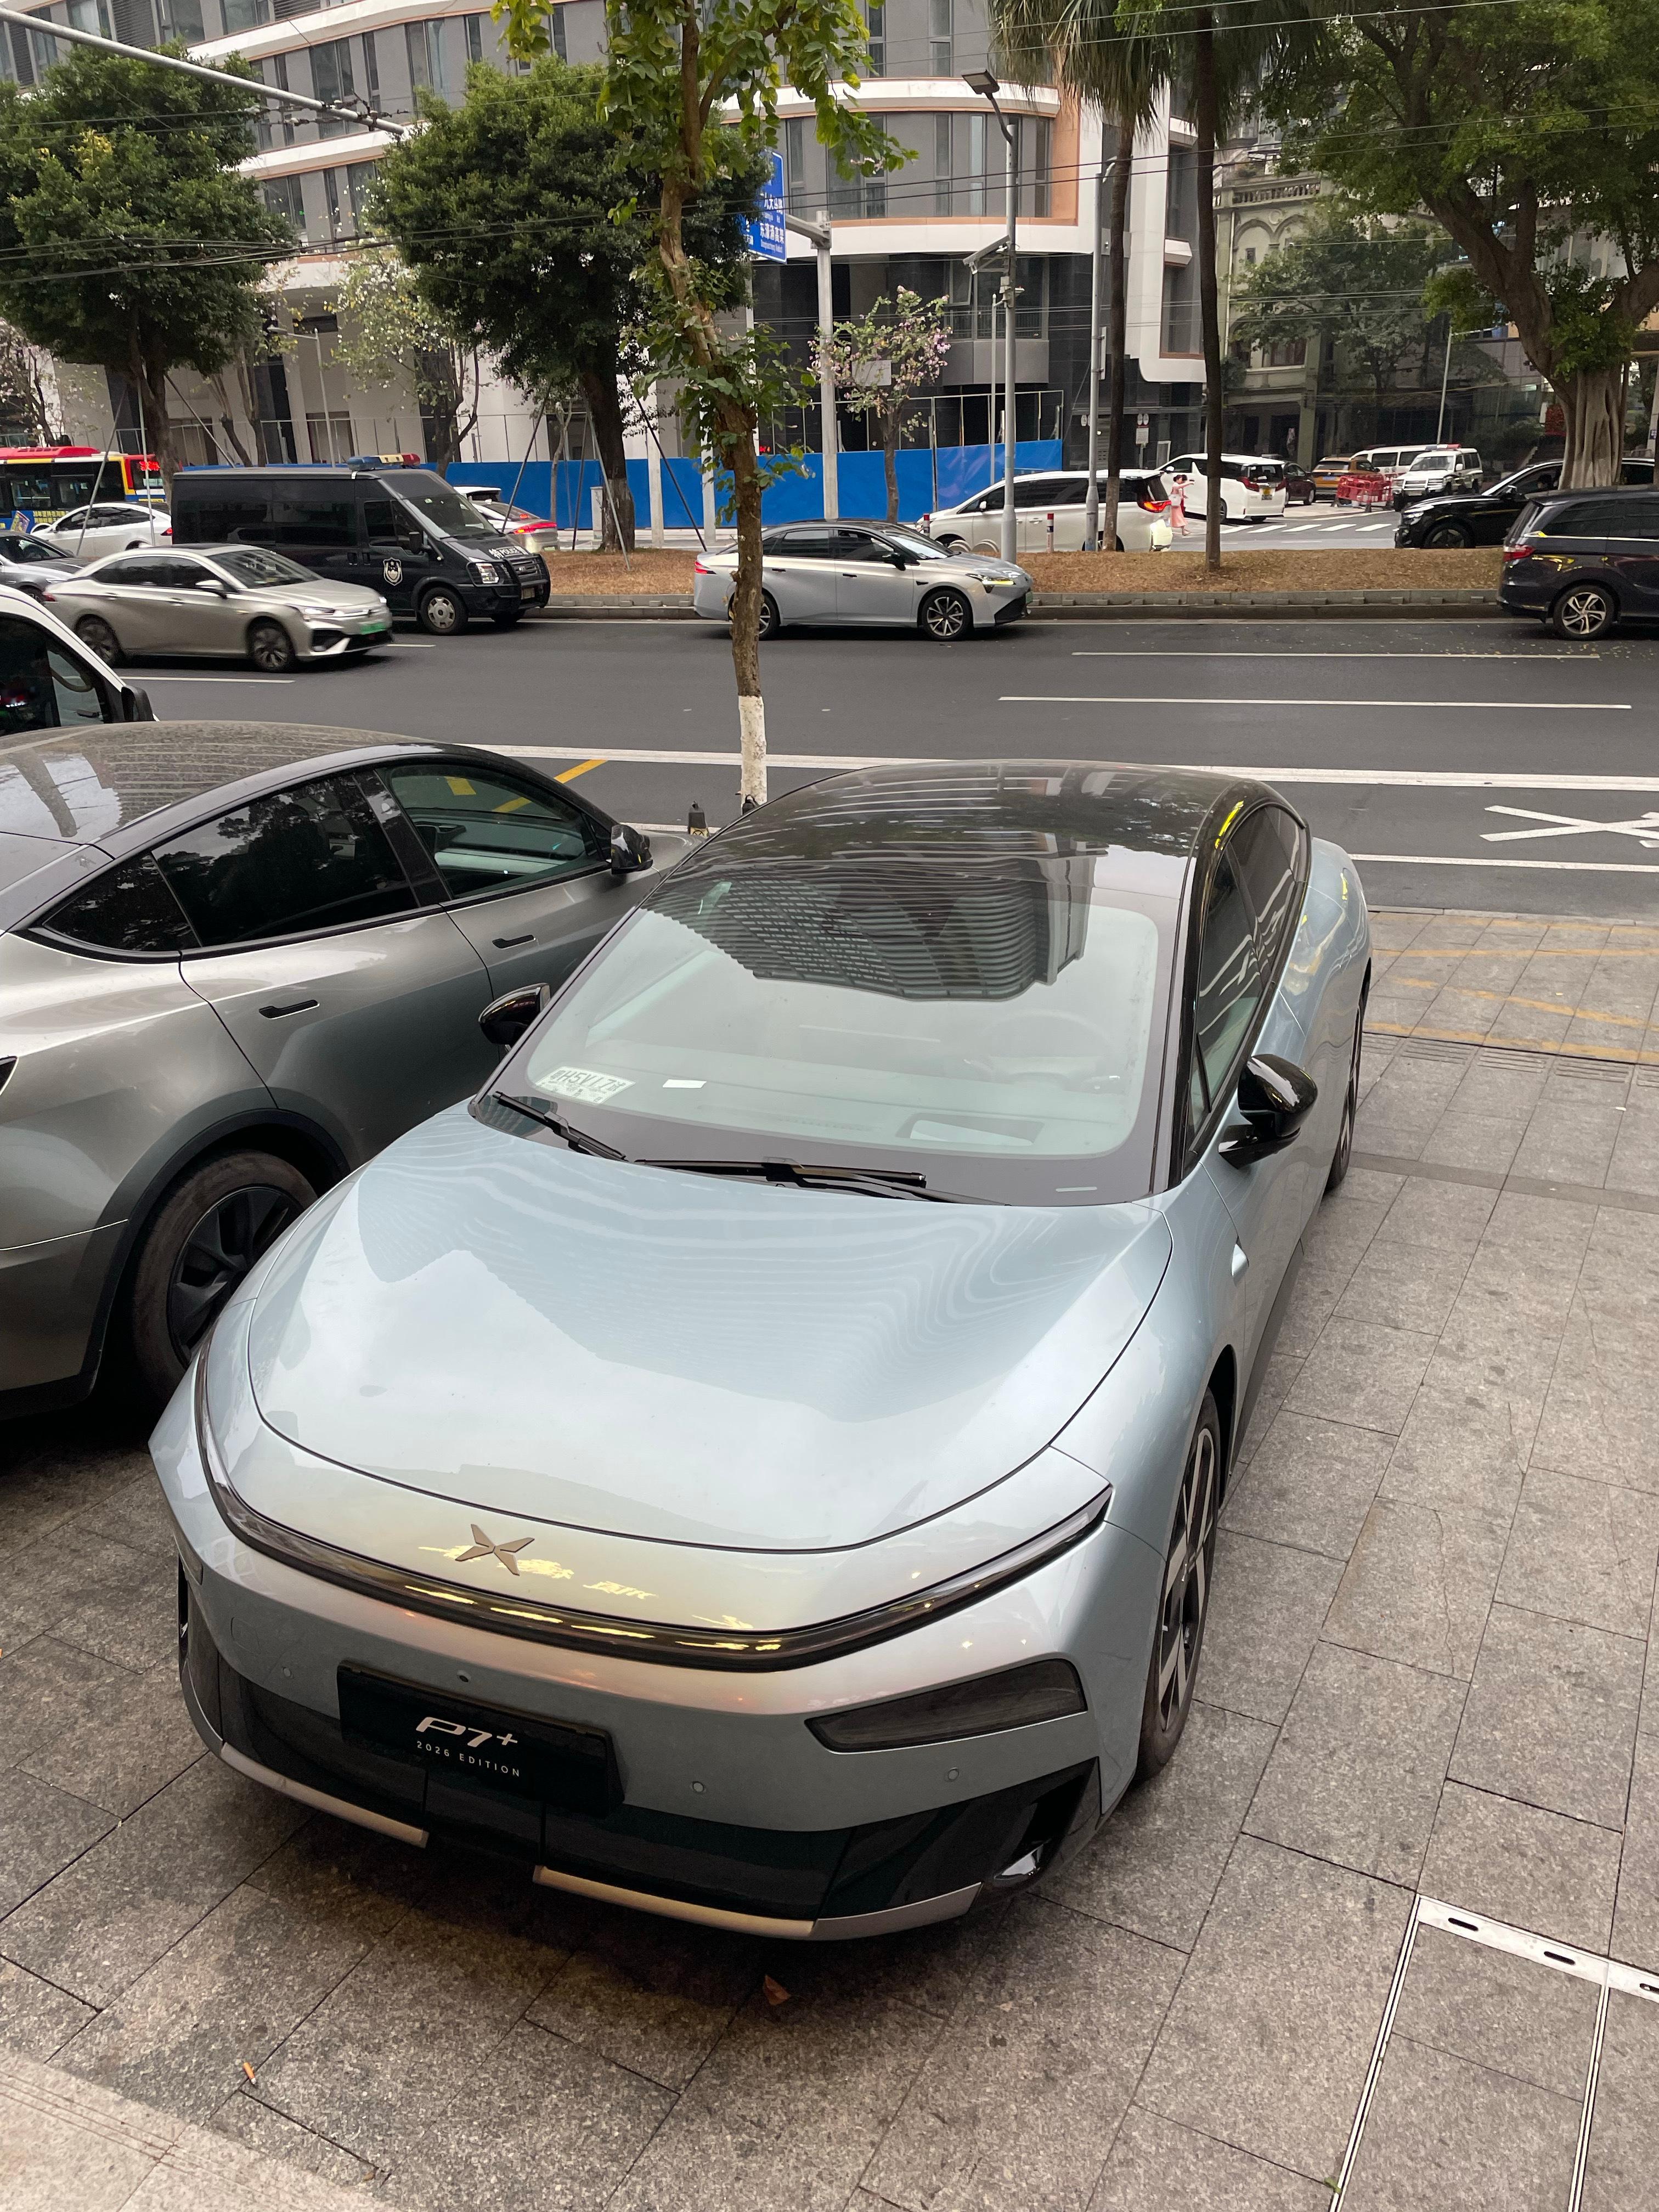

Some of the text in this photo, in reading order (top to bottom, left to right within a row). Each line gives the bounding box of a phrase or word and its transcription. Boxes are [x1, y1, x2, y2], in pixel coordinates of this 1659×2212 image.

[416, 1717, 518, 1747] P7+
[417, 1741, 520, 1777] 2026 EDITION
